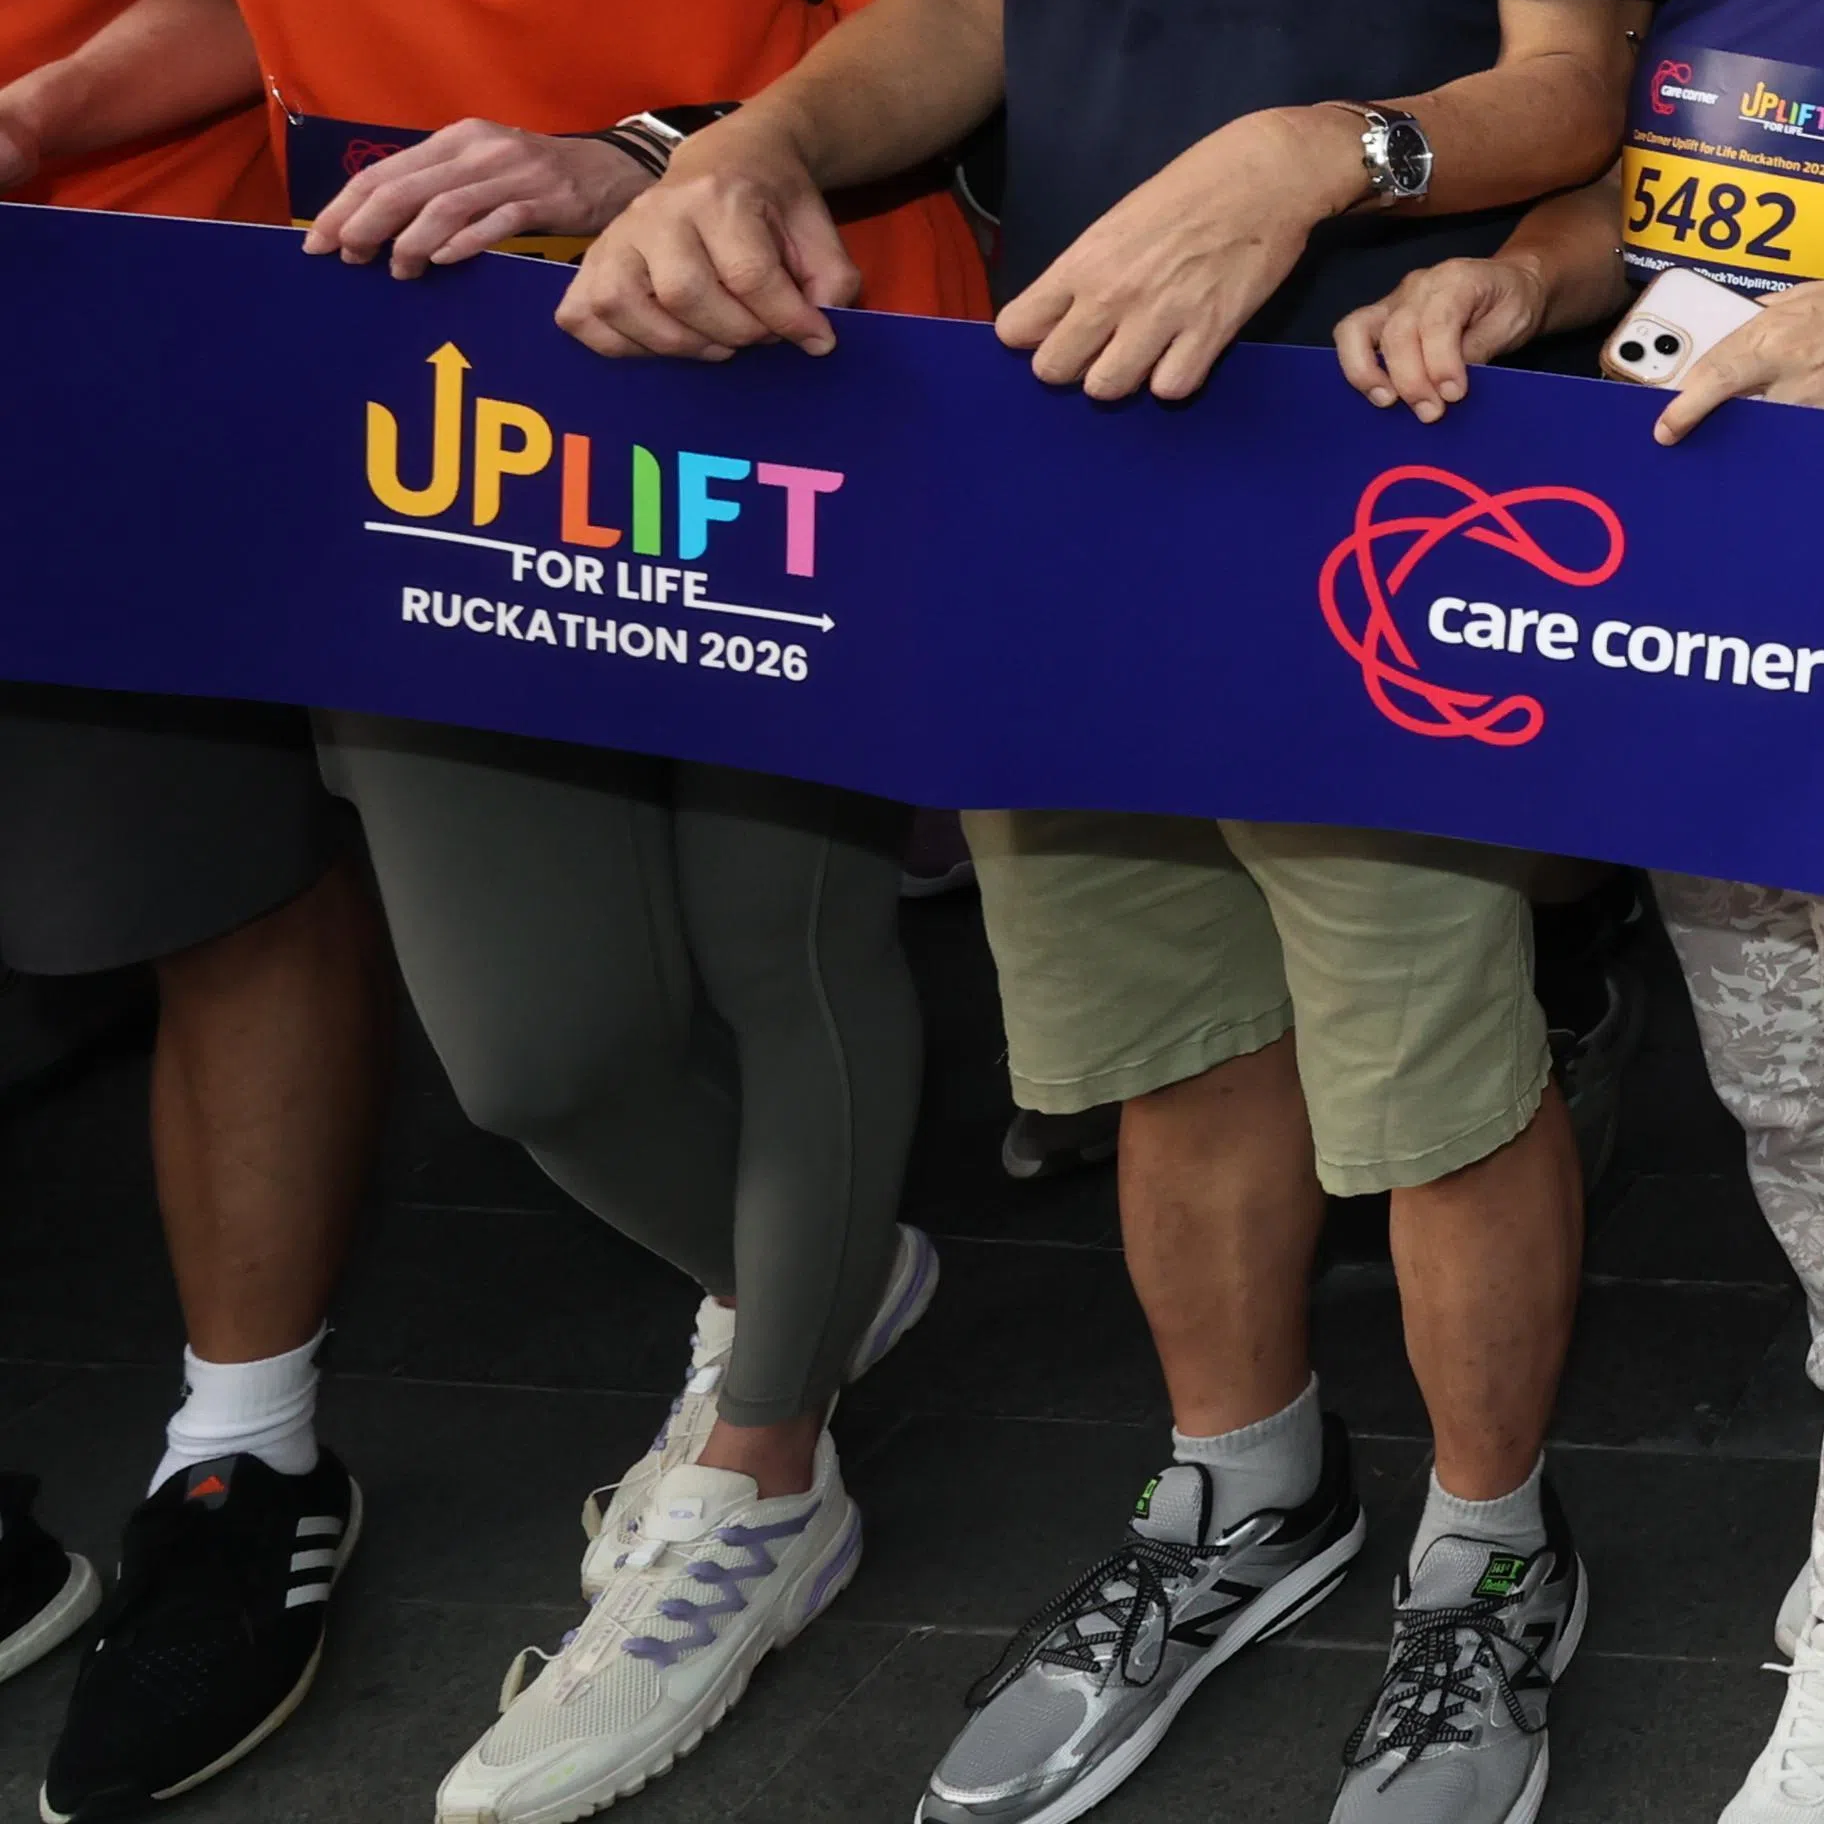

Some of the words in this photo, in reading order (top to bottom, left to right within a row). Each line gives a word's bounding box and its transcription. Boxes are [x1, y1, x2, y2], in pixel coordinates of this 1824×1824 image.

[1660, 84, 1681, 99] care
[1681, 88, 1719, 105] corner
[1672, 136, 1699, 152] Uplift
[1700, 141, 1715, 155] for
[1716, 145, 1737, 160] Life
[1739, 149, 1801, 171] Ruckathon
[1763, 121, 1783, 133] FOR
[1628, 166, 1796, 261] 5482
[367, 341, 844, 577] UPLIFT
[512, 546, 604, 595] FOR
[617, 561, 708, 608] LIFE
[402, 586, 688, 664] RUCKATHON
[699, 631, 808, 681] 2026
[1428, 596, 1579, 661] care
